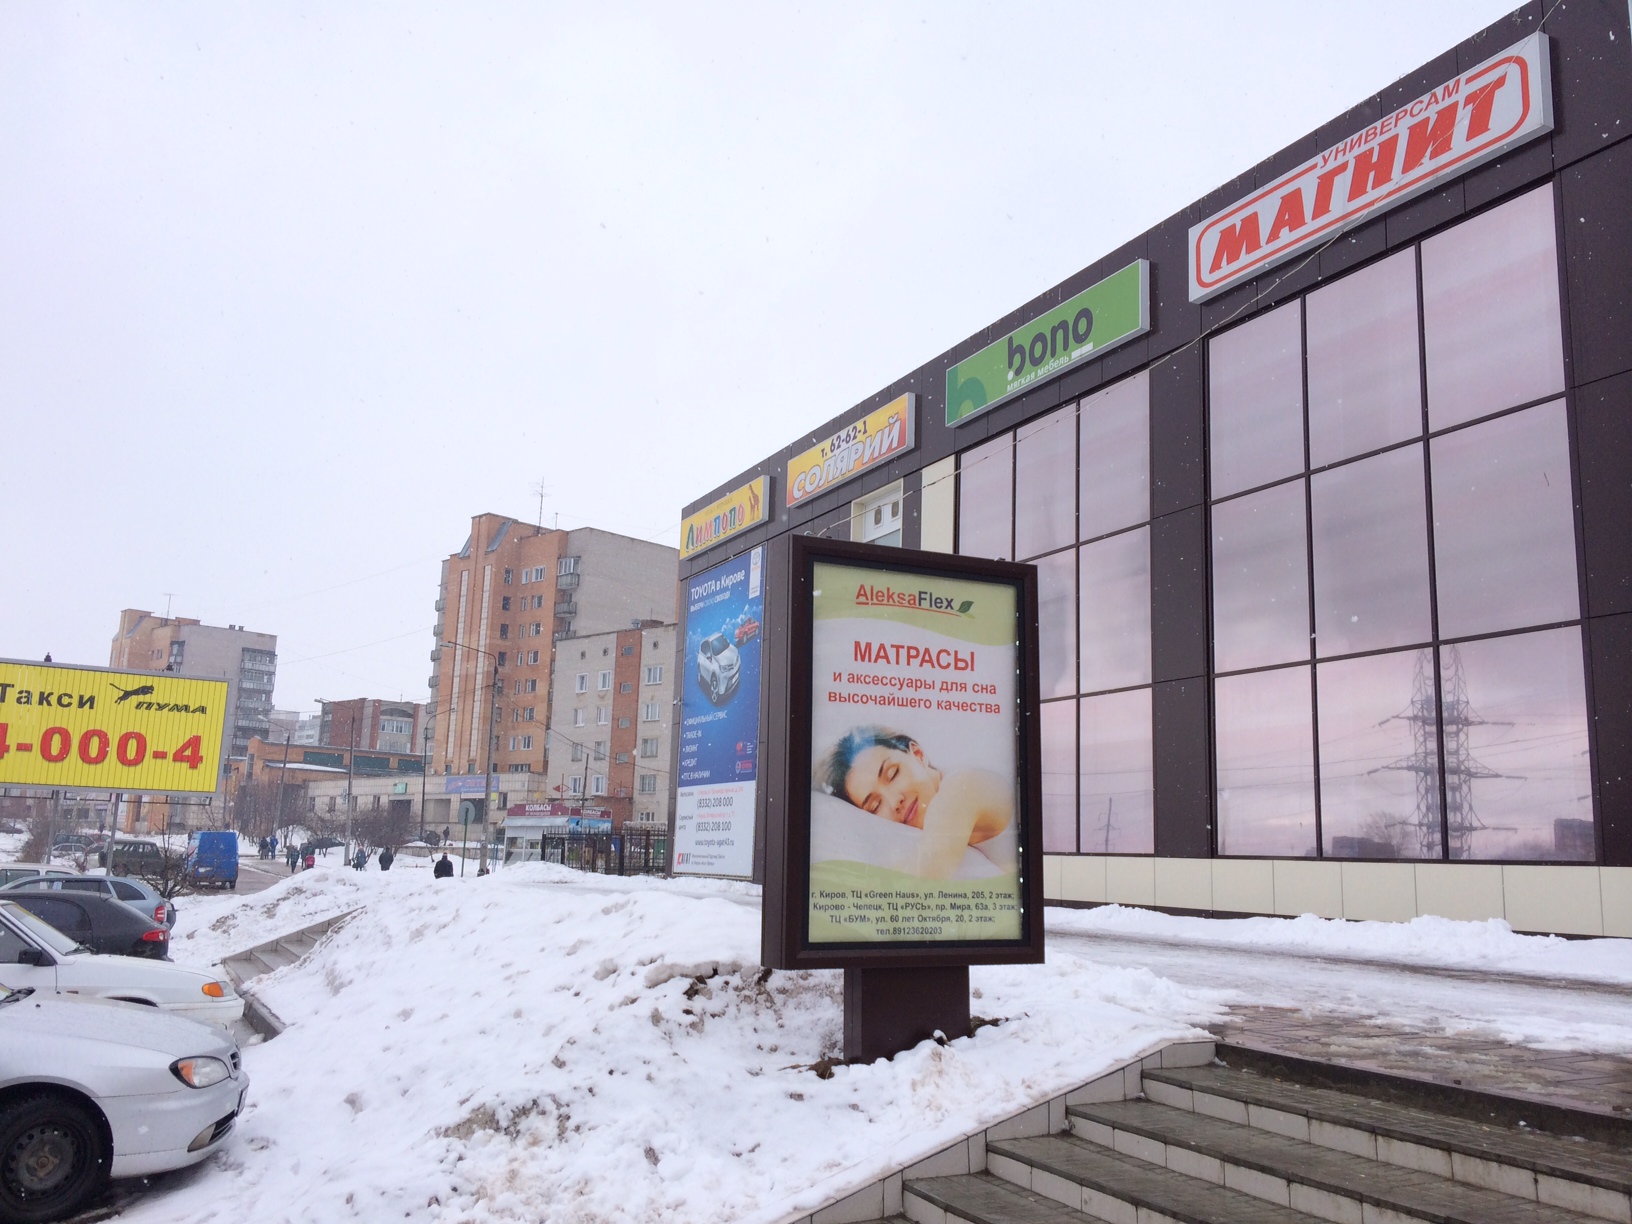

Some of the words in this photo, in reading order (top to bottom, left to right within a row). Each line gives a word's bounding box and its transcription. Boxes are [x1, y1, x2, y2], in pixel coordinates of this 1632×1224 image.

[1318, 77, 1461, 170] УНИВЕРСАМ
[1208, 71, 1508, 274] МАГНИТ
[1007, 307, 1093, 377] bono
[1006, 371, 1036, 392] мягкая
[1037, 354, 1069, 376] мебель
[821, 447, 828, 458] т.
[829, 420, 868, 454] 62-62-1
[792, 413, 902, 499] СОЛЯРИЙ
[685, 502, 745, 552] Лимпопо
[690, 579, 716, 601] TOYOTA
[716, 583, 720, 591] в
[720, 569, 746, 589] Кирове
[855, 584, 955, 611] AleksaFlex
[853, 640, 975, 672] МАТРАСЫ
[0, 682, 96, 710] Такси
[833, 671, 842, 682] и
[847, 673, 935, 691] аксессуары
[939, 681, 968, 694] для
[972, 684, 997, 695] сна
[135, 701, 207, 715] ПУМА
[828, 691, 932, 710] высочайшего
[936, 698, 1001, 714] качества
[525, 803, 552, 812] КОЛБАСЫ
[697, 798, 712, 809] (8332)
[712, 797, 722, 807] 208
[723, 796, 733, 806] 000
[696, 822, 711, 832] (8332)
[711, 821, 721, 831] 208
[722, 821, 731, 831] 100
[813, 903, 845, 912] Кирово
[852, 903, 885, 913] Чепецк,
[887, 903, 898, 912] ТЦ
[900, 903, 934, 912] «РУСЬ»,
[935, 904, 948, 913] пр.
[950, 903, 973, 912] Мира,
[974, 903, 990, 912] 63а,
[992, 903, 997, 911] 3
[819, 890, 849, 900] Киров,
[851, 891, 862, 900] ТЦ
[864, 891, 894, 899] «Green
[895, 891, 922, 900] Haus»,
[924, 893, 935, 901] ул.
[938, 891, 969, 900] Ленина,
[971, 891, 987, 900] 205,
[989, 891, 994, 899] 2
[829, 915, 841, 924] ТЦ
[843, 915, 873, 924] «БУМ»,
[875, 916, 888, 925] ул.
[889, 915, 899, 923] 60
[917, 914, 953, 924] Октября,
[955, 914, 967, 924] 20,
[968, 914, 973, 923] 2
